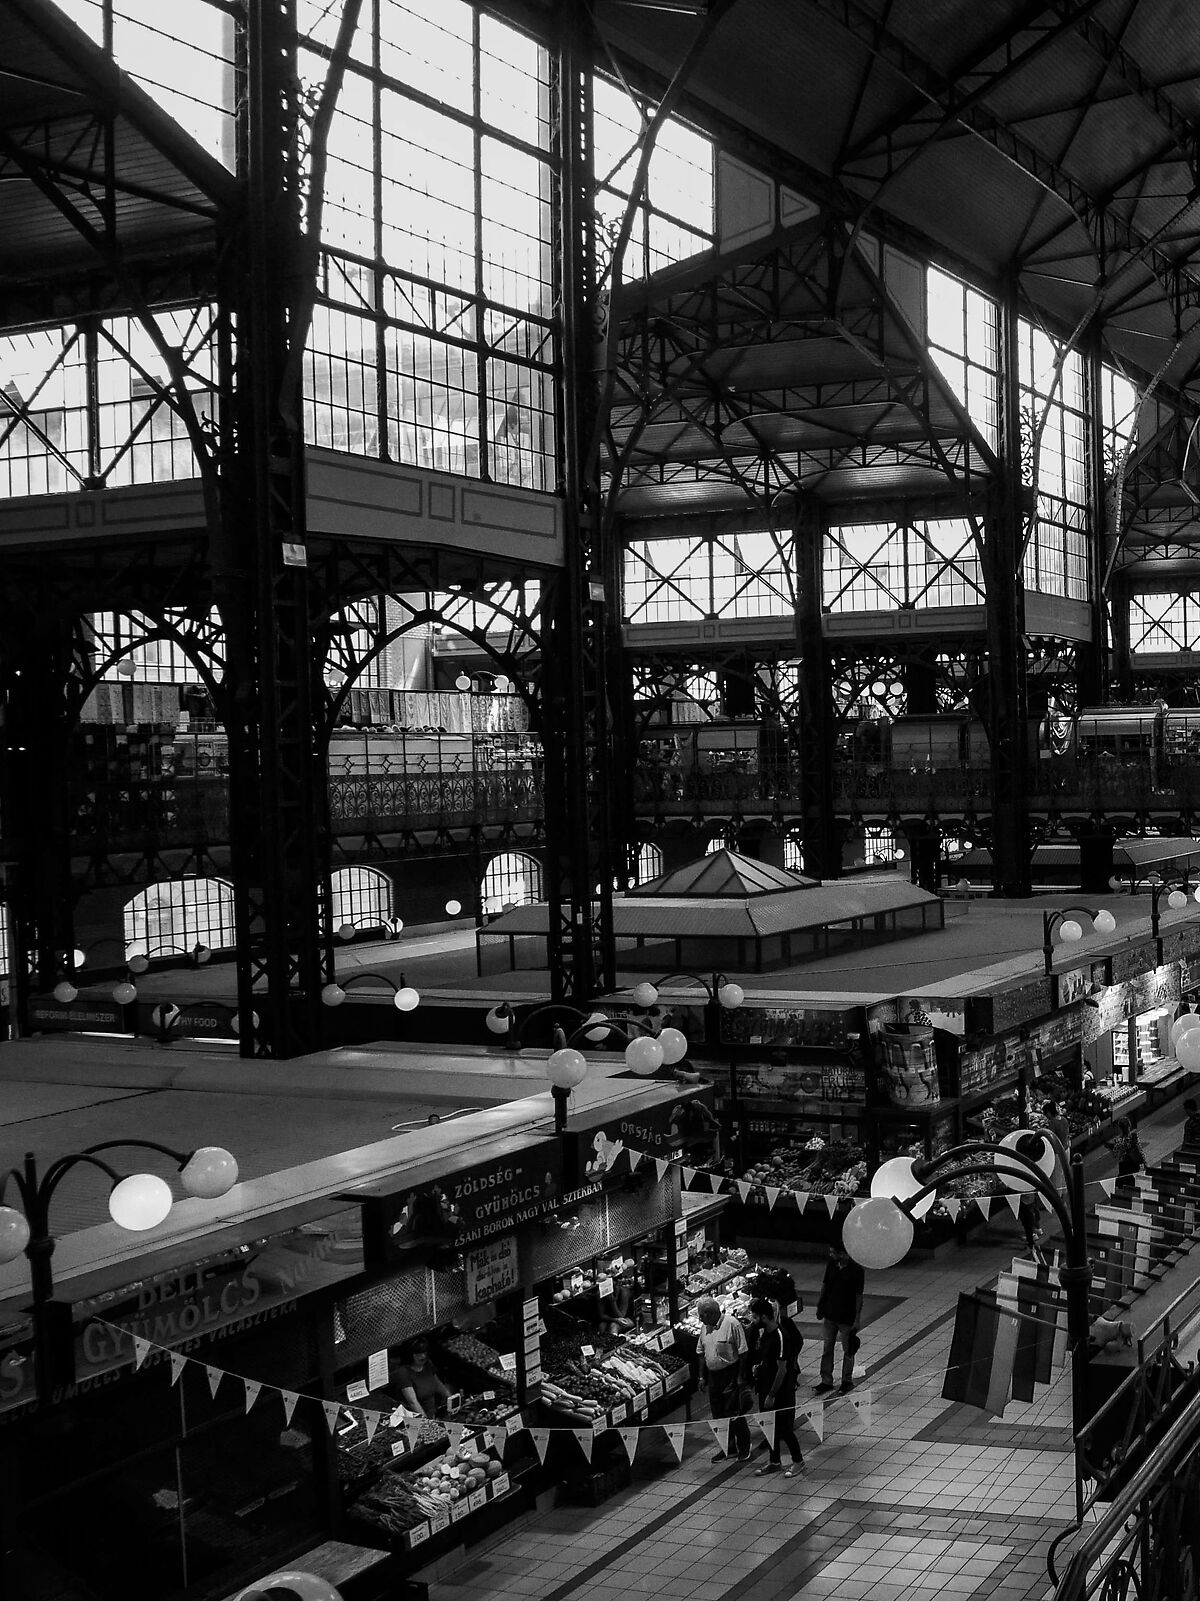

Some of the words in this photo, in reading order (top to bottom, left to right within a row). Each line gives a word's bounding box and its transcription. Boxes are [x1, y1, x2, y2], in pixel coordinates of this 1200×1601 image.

[620, 1121, 662, 1145] ORSZÁG
[454, 1166, 523, 1199] ZÖLDSÉG-
[475, 1184, 541, 1220] GYÜMÖLCS
[483, 1215, 516, 1239] BOROK
[515, 1206, 540, 1226] NAGY
[82, 1261, 260, 1364] GYÜMÖLCS
